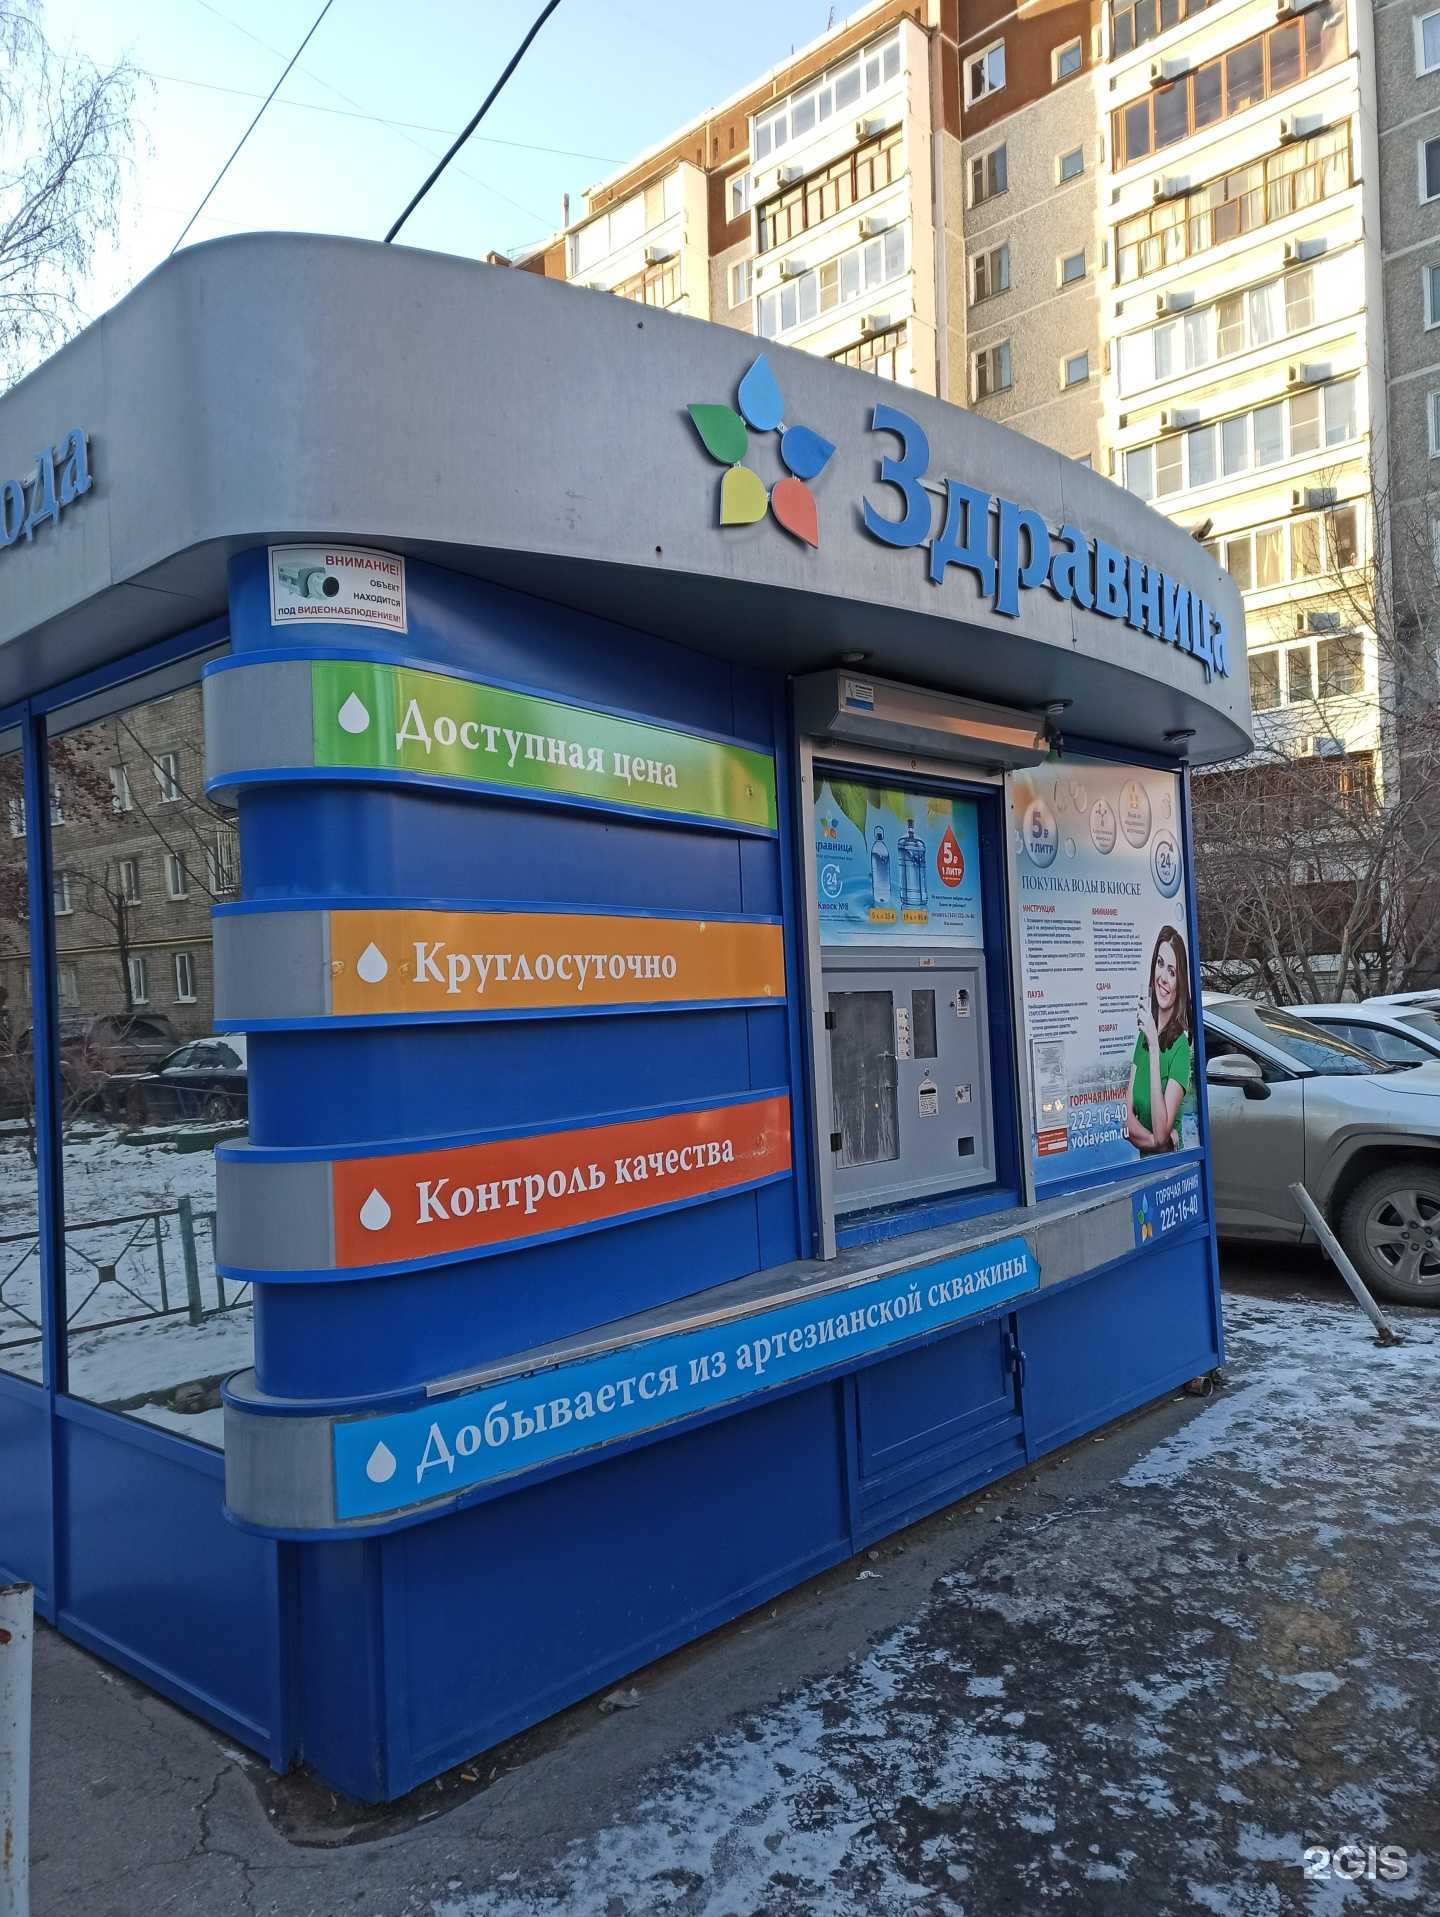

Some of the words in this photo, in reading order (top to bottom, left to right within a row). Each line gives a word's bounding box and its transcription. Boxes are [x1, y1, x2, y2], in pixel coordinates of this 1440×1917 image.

[863, 403, 1231, 684] Здравница
[325, 555, 400, 577] ВНИМАНИЕ!
[369, 579, 400, 593] ОБЪЕКТ
[353, 592, 401, 608] НАХОДИТСЯ
[277, 606, 296, 616] ПОД
[297, 605, 401, 624] ВИДЕОНАБЛЮДЕНИЕМ!
[395, 698, 605, 774] Доступная
[612, 751, 679, 789] цена
[1031, 811, 1043, 839] 5
[815, 840, 853, 853] равница
[942, 842, 953, 865] 5
[1035, 843, 1054, 855] ЛИТР
[946, 866, 962, 876] ЛИТР
[1159, 853, 1171, 869] 24
[825, 872, 838, 887] 24
[1022, 875, 1070, 891] ПОКУПКА
[1072, 878, 1100, 894] ВОДЫ
[1099, 882, 1107, 894] В
[1107, 883, 1142, 896] КИОСКЕ
[818, 901, 838, 911] Киоск
[1023, 904, 1056, 915] ИНСТРУКЦИЯ
[412, 941, 678, 994] Круглосуточно
[1027, 990, 1045, 999] ПАУЗА
[1096, 982, 1112, 992] СДАЧА
[1098, 1023, 1119, 1033] ВОЗВРАТ
[1069, 1089, 1102, 1107] ГОРЯЧАЯ
[1102, 1085, 1128, 1103] ЛИНИЯ
[1069, 1103, 1128, 1132] 222-16-40
[1071, 1125, 1130, 1150] vodavsem.ru
[415, 1177, 606, 1225] Контроль
[613, 1138, 735, 1186] качества
[1154, 1180, 1184, 1206] ГОРЯЧАЯ
[1181, 1173, 1199, 1195] ЛИНИЯ
[1159, 1192, 1198, 1232] 222-16-40
[416, 1364, 679, 1485] Добывается
[689, 1350, 727, 1386] из
[736, 1283, 923, 1375] артезианской
[927, 1252, 1029, 1309] скважины
